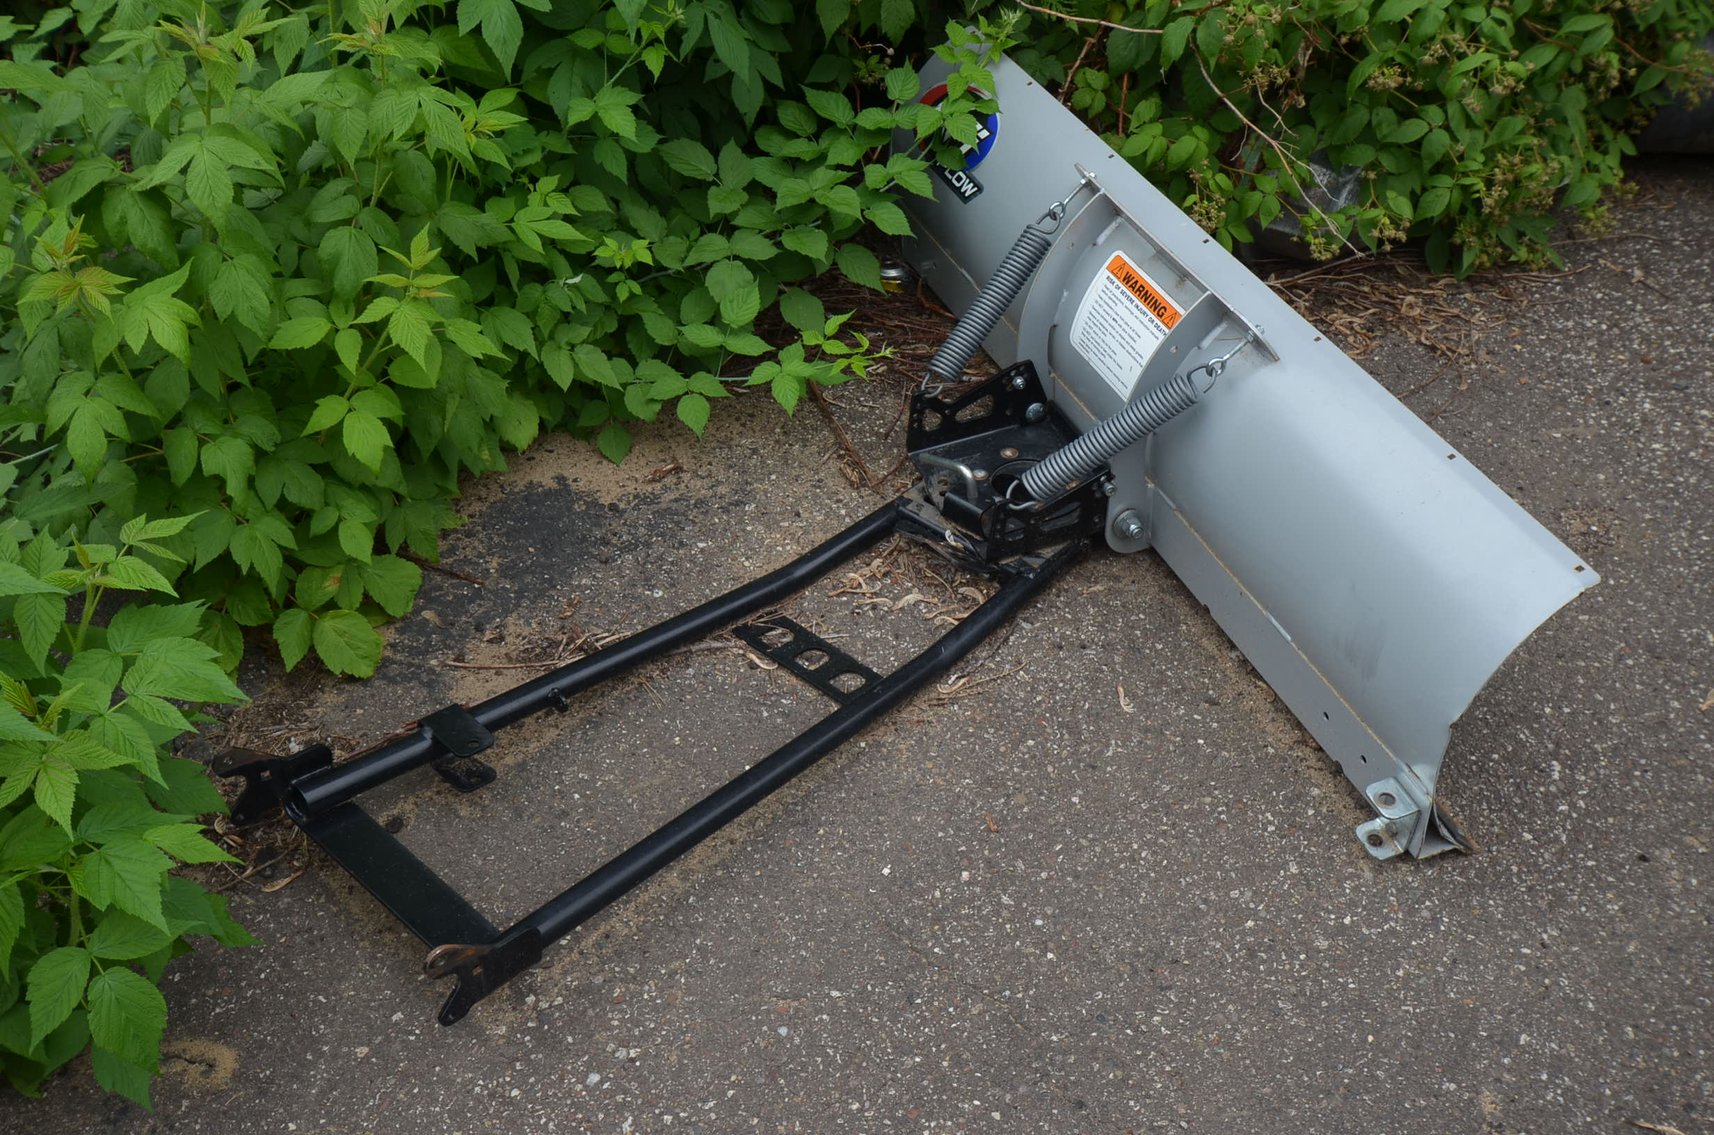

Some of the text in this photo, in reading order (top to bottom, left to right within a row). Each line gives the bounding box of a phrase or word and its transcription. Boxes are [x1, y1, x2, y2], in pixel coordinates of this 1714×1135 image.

[1106, 275, 1116, 285] RISK
[1120, 289, 1135, 304] SEVERE
[1134, 302, 1149, 318] INJURY
[1147, 316, 1155, 325] OR
[1154, 322, 1167, 336] DEATH
[1122, 271, 1167, 318] WARNING
